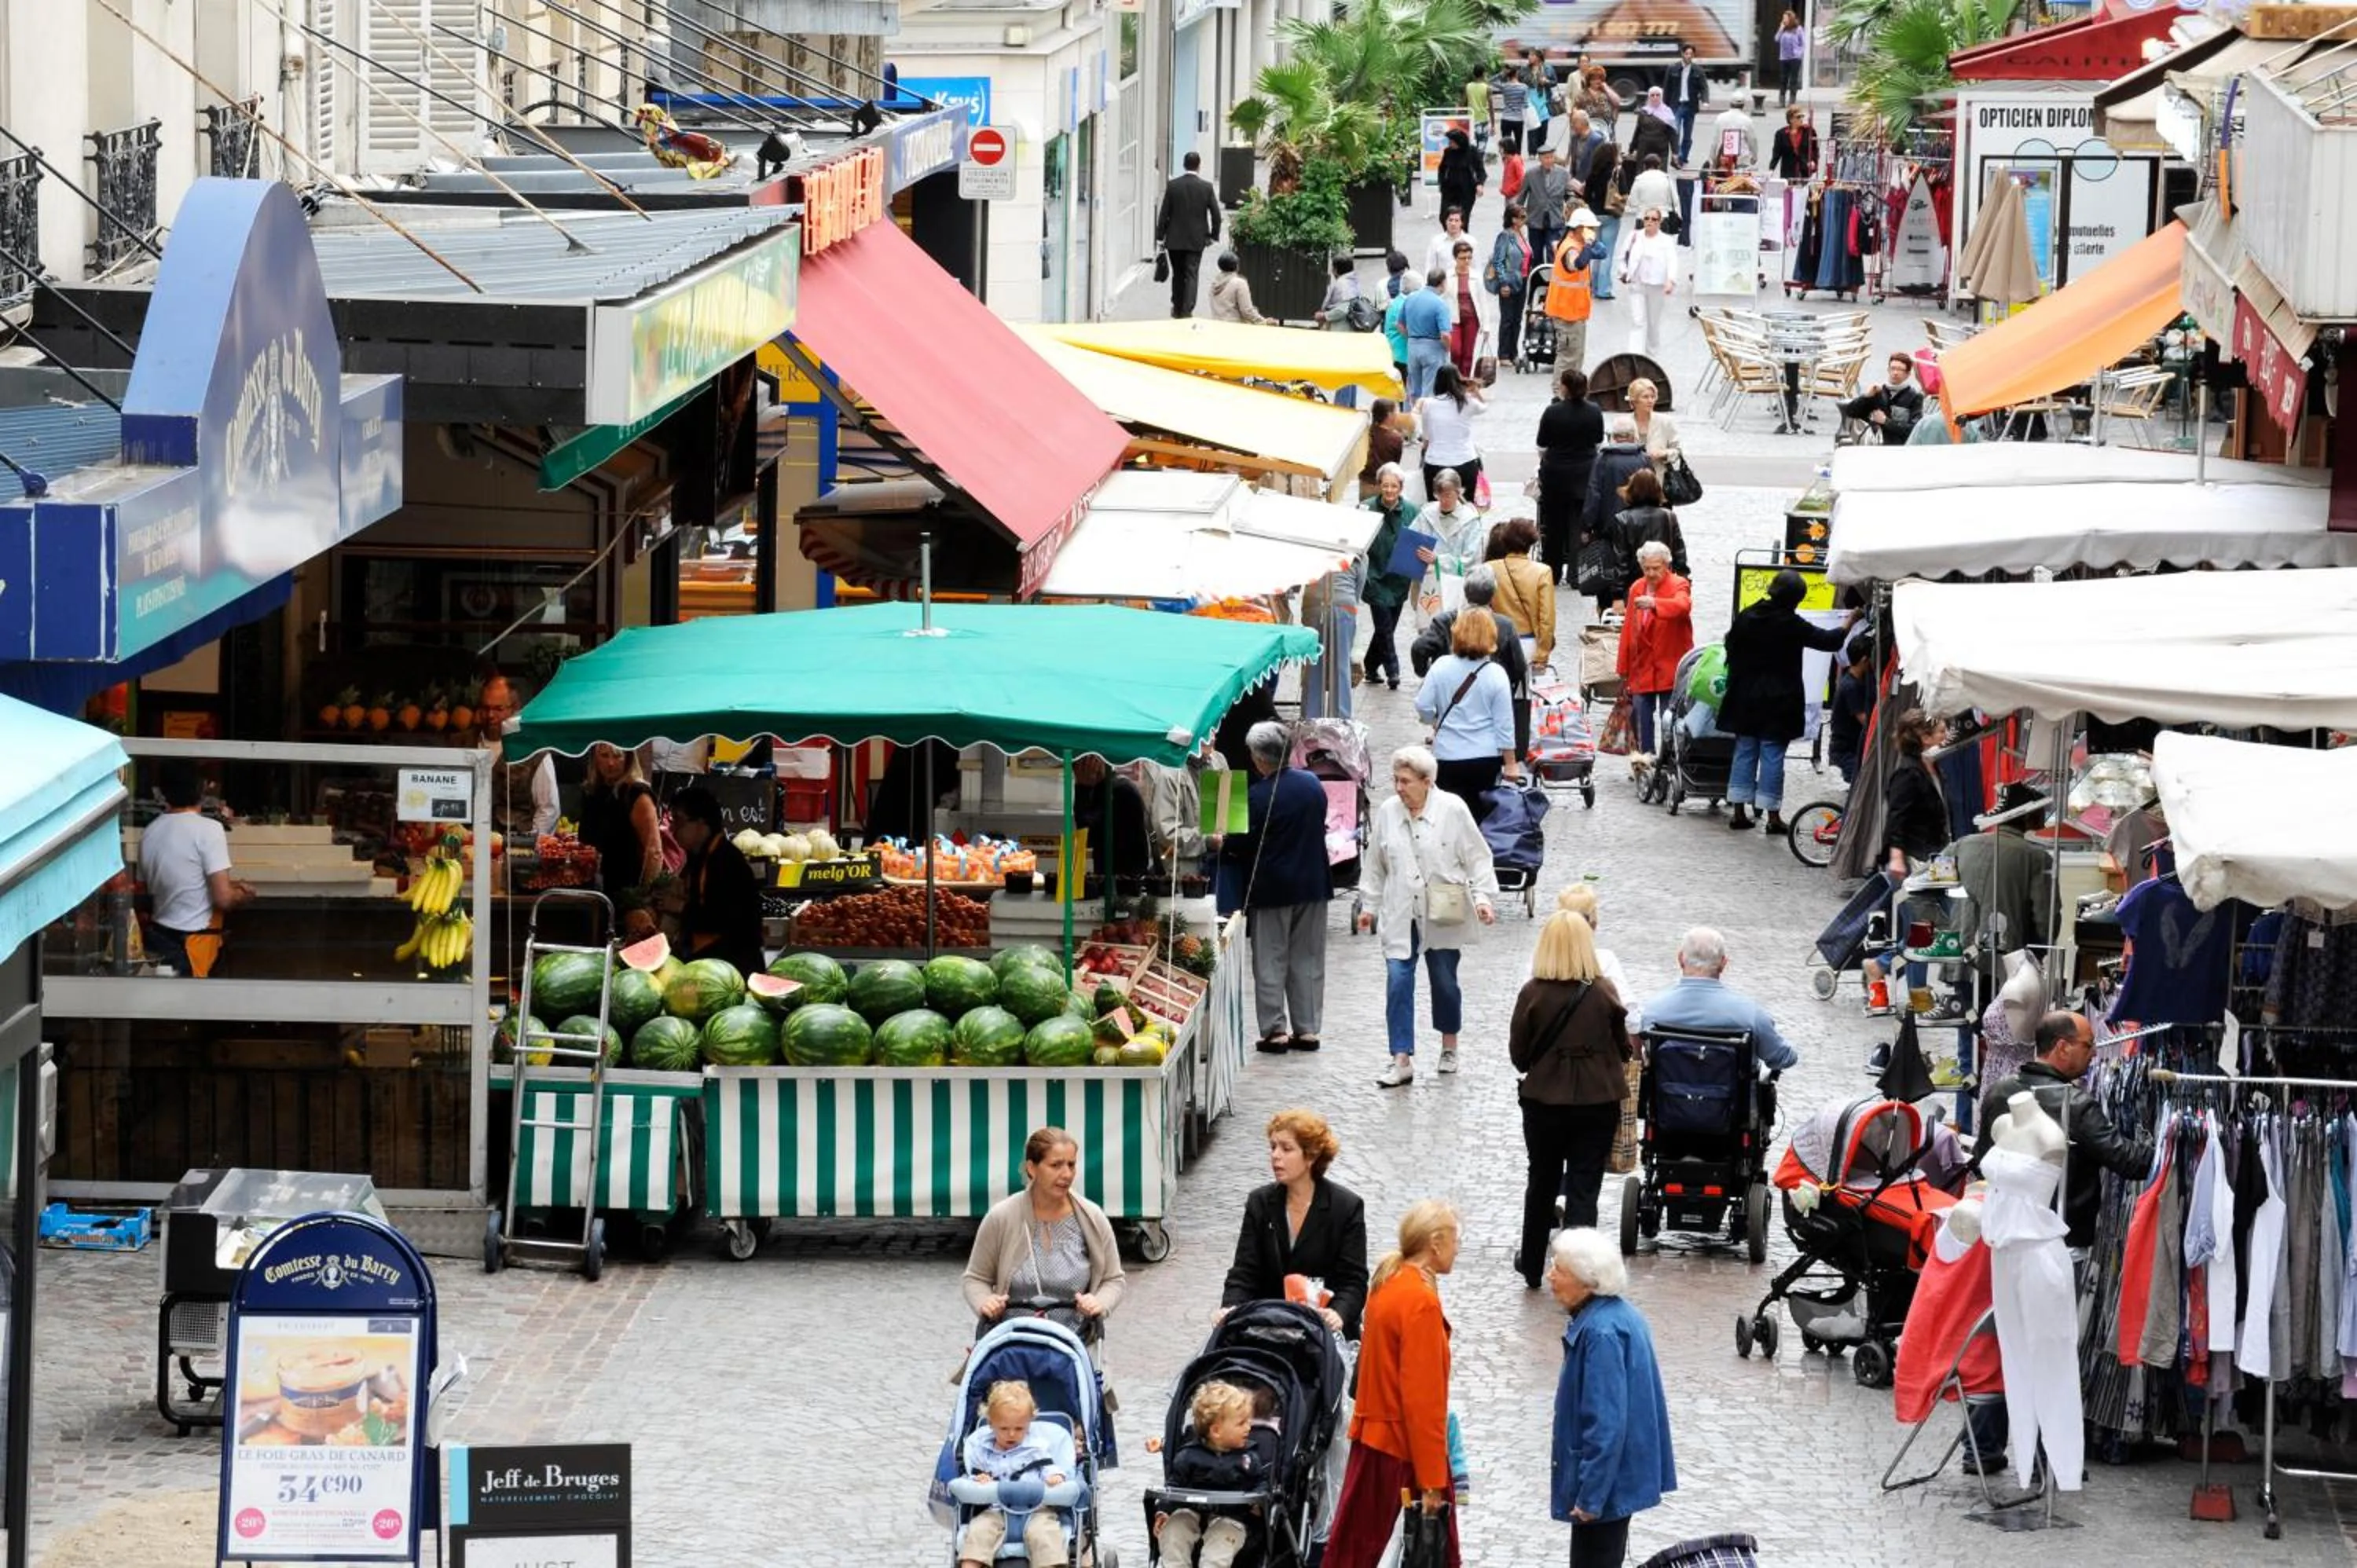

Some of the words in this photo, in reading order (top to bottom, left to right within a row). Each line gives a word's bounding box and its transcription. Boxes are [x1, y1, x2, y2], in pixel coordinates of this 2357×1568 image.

[1979, 108, 2043, 128] OPTICIEN
[411, 774, 457, 785] BANANE
[739, 797, 767, 823] est
[808, 864, 871, 881] melg'OR
[264, 1255, 322, 1284] Comtesse
[344, 1254, 358, 1268] du
[361, 1255, 401, 1286] Barry
[238, 1450, 251, 1460] LE
[256, 1449, 286, 1460] FOIE
[289, 1449, 325, 1461] GRAS
[329, 1450, 343, 1461] DE
[349, 1449, 407, 1463] CANARD
[480, 1468, 522, 1494] Jeff
[523, 1474, 541, 1488] de
[543, 1464, 620, 1493] Bruges
[481, 1493, 561, 1503] NATURELLEMENT
[566, 1492, 619, 1501] CHOCOLAT
